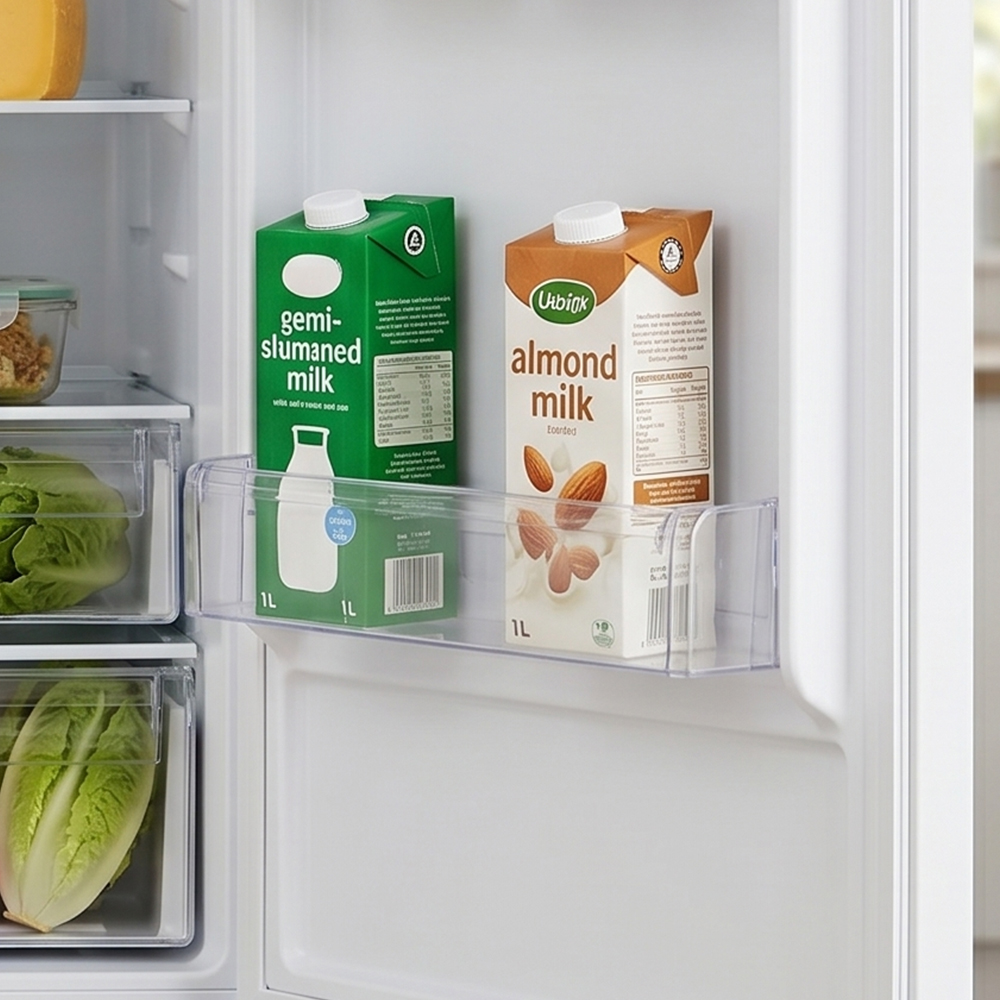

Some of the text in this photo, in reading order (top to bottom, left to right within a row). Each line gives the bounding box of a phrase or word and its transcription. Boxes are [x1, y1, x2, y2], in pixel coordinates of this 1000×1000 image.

[280, 305, 342, 336] gemi-
[511, 339, 617, 380] almond
[287, 365, 335, 394] milk
[531, 382, 594, 422] milk
[261, 591, 277, 608] 1L
[341, 600, 357, 616] 1L
[511, 619, 531, 638] 1L
